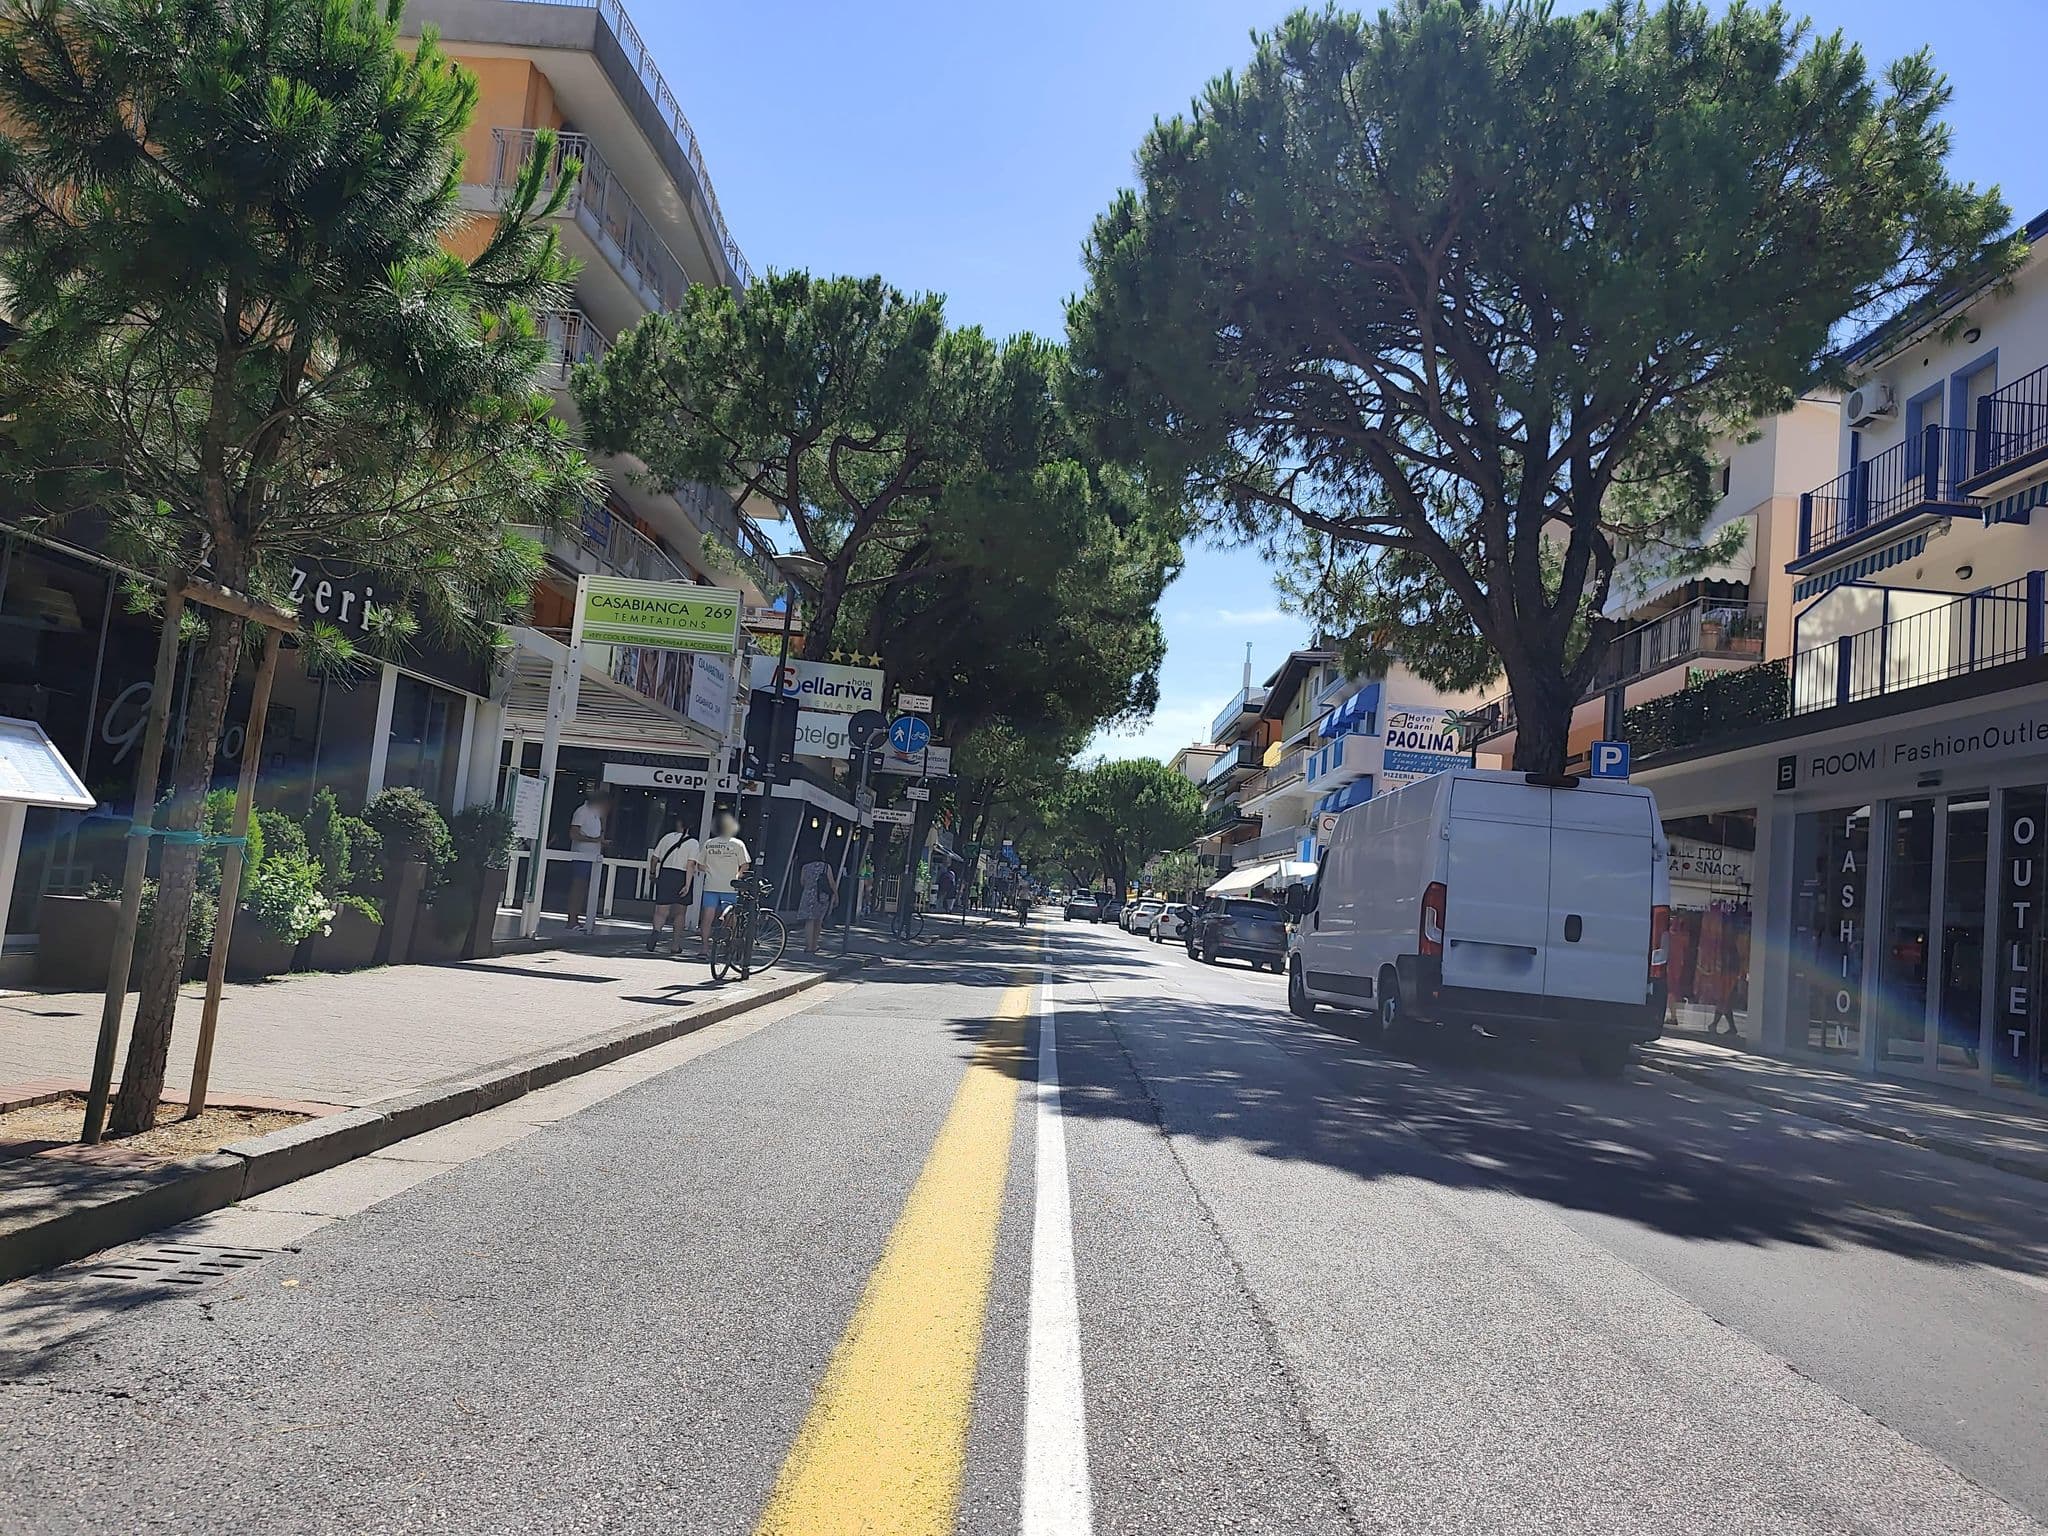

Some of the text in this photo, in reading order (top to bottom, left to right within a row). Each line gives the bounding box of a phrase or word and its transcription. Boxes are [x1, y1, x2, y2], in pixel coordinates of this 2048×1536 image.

[591, 595, 733, 620] CASABIANCA 269
[614, 612, 707, 630] TEMPTATIONS
[768, 664, 873, 702] Bellariva
[851, 677, 873, 688] hotel
[1406, 722, 1433, 731] Garni
[1408, 713, 1436, 723] Hotel
[796, 725, 855, 750] otelgr
[1386, 730, 1454, 752] PAOLINA
[1391, 757, 1418, 766] Zimmer
[1392, 751, 1418, 760] Camere
[1434, 755, 1469, 764] Colazione
[1600, 746, 1622, 773] P
[1811, 748, 1878, 778] ROOM
[653, 770, 731, 790] Cevapci
[1383, 771, 1415, 781] PIZZERIA
[1694, 860, 1742, 877] SNACK
[1835, 814, 1858, 1049] FASHION
[2007, 816, 2035, 1058] OUTLET
